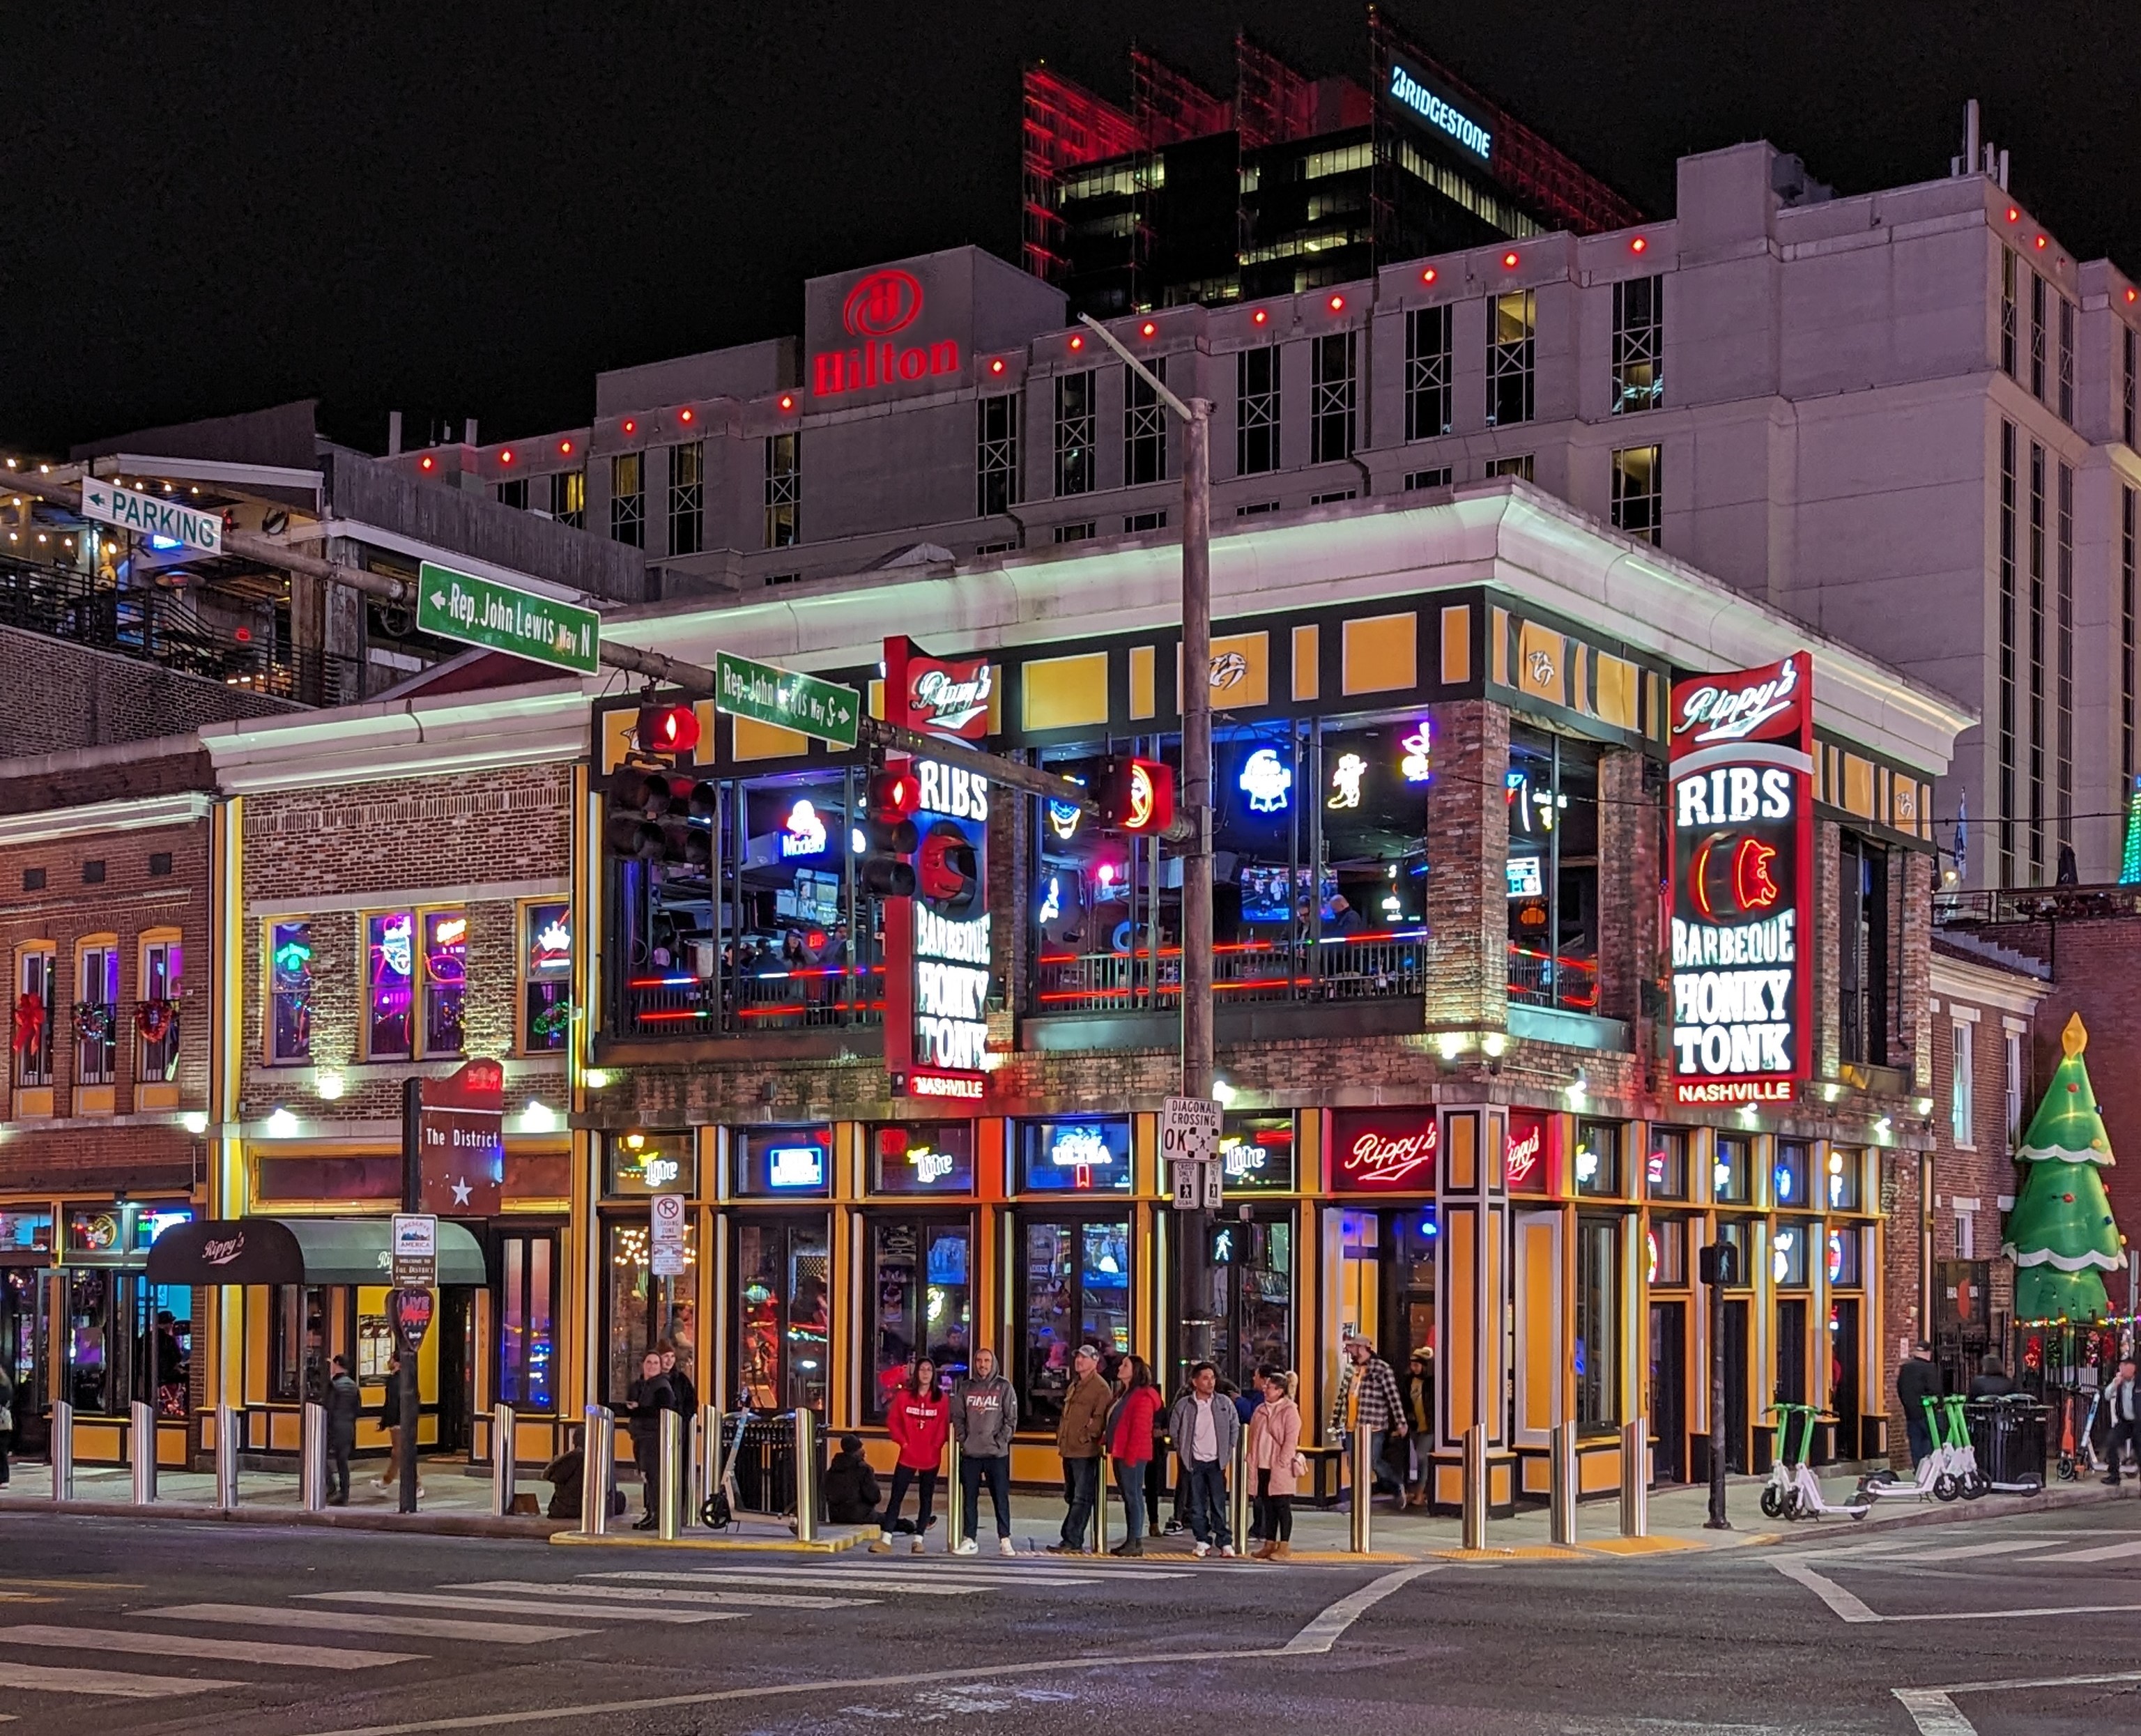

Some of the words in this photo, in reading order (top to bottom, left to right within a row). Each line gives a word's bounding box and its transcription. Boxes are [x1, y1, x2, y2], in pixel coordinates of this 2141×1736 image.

[1391, 66, 1491, 159] BRIDGESTONE
[813, 339, 960, 396] Hilton
[112, 490, 215, 548] PARKING
[450, 583, 479, 629] Rep.
[480, 592, 513, 633] John
[517, 601, 555, 645] Lewis
[559, 624, 577, 656] Way
[581, 623, 590, 657] N
[723, 663, 747, 705] Rep.
[748, 670, 774, 707] John
[811, 697, 825, 727] Way
[827, 696, 836, 728] S
[1673, 659, 1797, 734] Rippy's
[919, 760, 989, 822] RIBS
[1676, 767, 1790, 827] RIBS
[916, 900, 992, 965] BARBEQUE
[1672, 908, 1796, 969] BARBEQUE
[918, 961, 990, 1020] HONKY
[1673, 969, 1791, 1024] HONKY
[919, 1015, 990, 1071] TONK
[1674, 1023, 1791, 1075] TONK
[912, 1076, 983, 1098] NASHVILLE
[1172, 1100, 1216, 1114] DIAGONAL
[1678, 1082, 1790, 1102] NASHVILLE
[427, 1128, 445, 1146] The
[454, 1129, 498, 1148] District
[1165, 1128, 1187, 1151] OK
[1172, 1112, 1215, 1126] CROSSING
[1344, 1122, 1437, 1169] Rippy's
[202, 1231, 244, 1259] Rippy's
[402, 1296, 429, 1310] LIVE
[966, 1395, 999, 1406] FINAL
